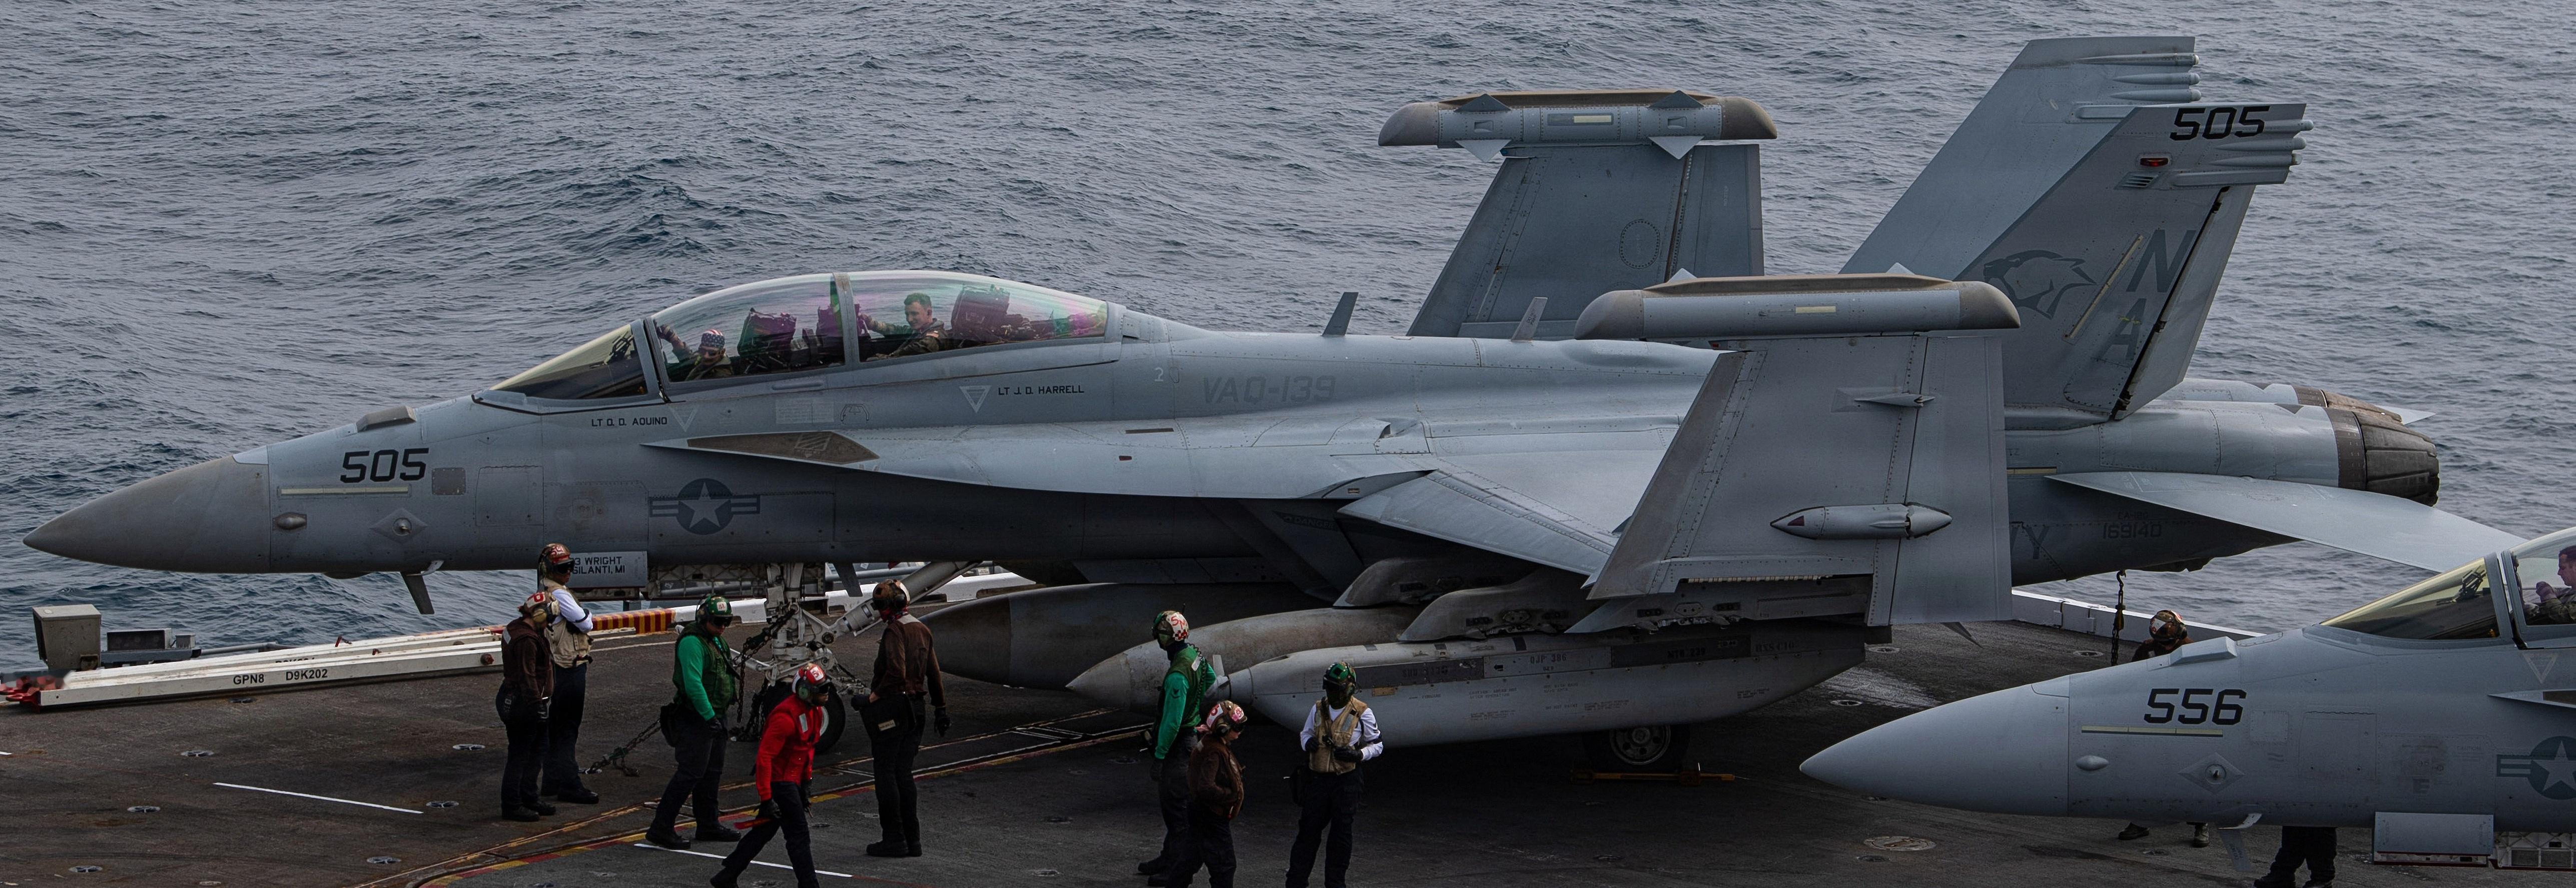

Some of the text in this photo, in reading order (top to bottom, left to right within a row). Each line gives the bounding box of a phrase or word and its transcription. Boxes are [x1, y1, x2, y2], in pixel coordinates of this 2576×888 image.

[2170, 106, 2270, 141] 505
[2126, 229, 2196, 293] N
[2104, 298, 2146, 359] A
[1154, 367, 1163, 382] 2
[998, 387, 1010, 395] LT
[1025, 386, 1033, 394] D.
[1038, 385, 1084, 394] HARRELL
[1203, 375, 1336, 404] VAQ-139
[591, 419, 603, 427] LT
[618, 418, 626, 426] D.
[632, 417, 667, 425] AQUINO
[340, 448, 429, 482] 505
[2103, 523, 2162, 539] 169140
[585, 556, 622, 565] WRIGHT
[615, 565, 625, 573] MI
[233, 669, 328, 685] GPN8 D9K202
[2144, 688, 2247, 725] 556
